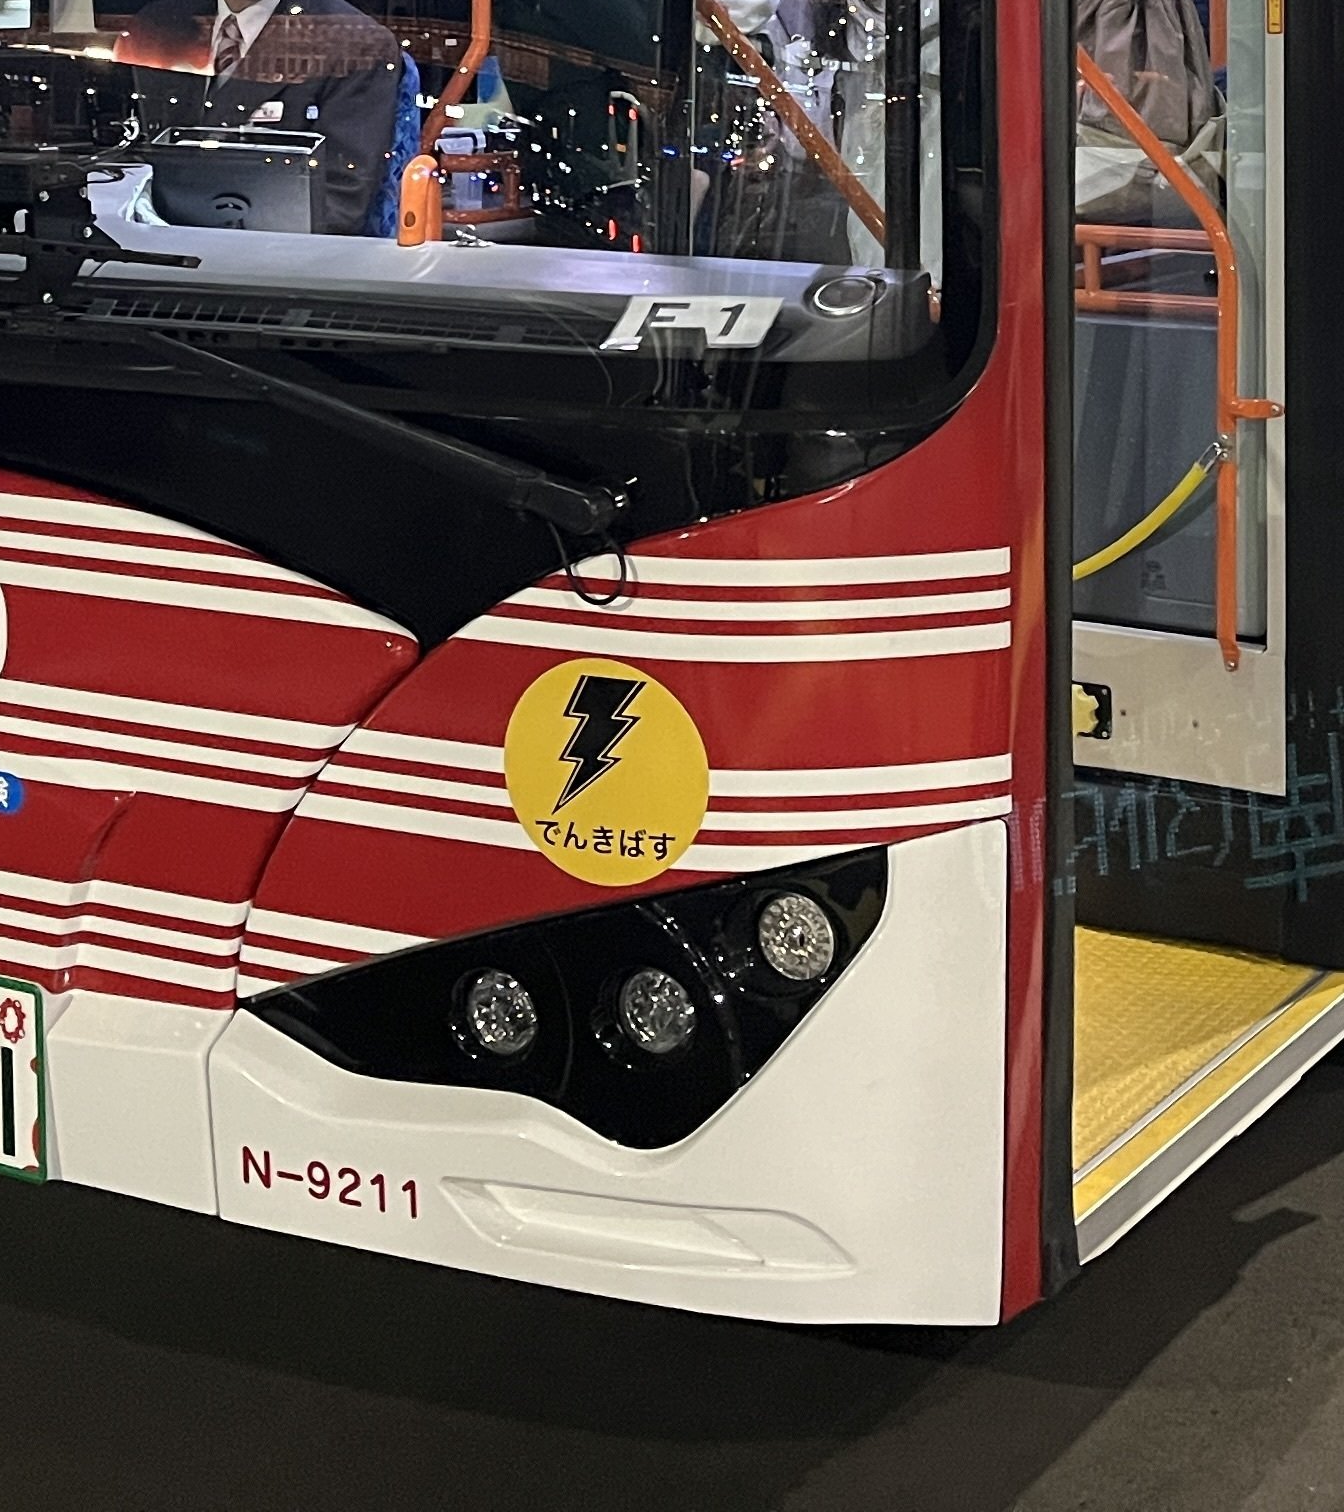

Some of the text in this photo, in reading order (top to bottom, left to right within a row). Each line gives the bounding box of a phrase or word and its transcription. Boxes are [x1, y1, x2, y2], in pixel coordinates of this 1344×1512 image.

[534, 819, 676, 862] でんきばす
[241, 1144, 419, 1220] N-9211
